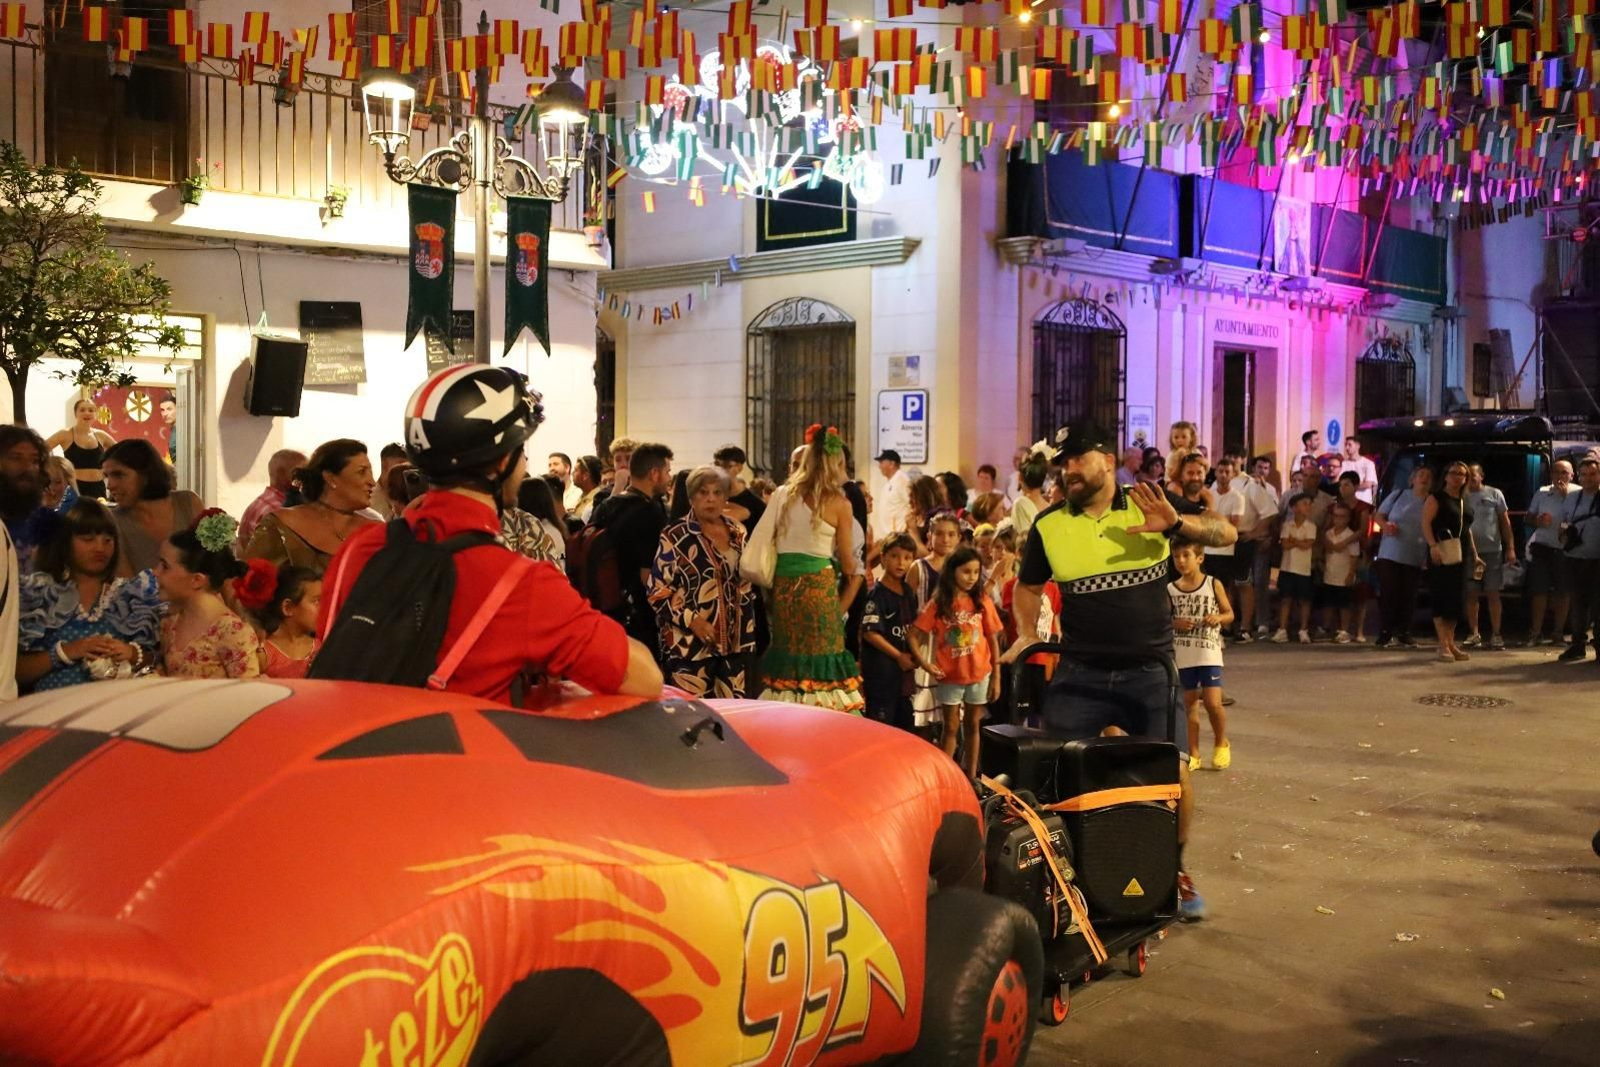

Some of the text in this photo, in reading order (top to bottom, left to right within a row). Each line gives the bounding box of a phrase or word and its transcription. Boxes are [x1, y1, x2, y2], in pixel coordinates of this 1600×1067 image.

[1214, 318, 1279, 338] AYUNTAMIENTO
[906, 396, 921, 419] P
[738, 879, 849, 1067] 95
